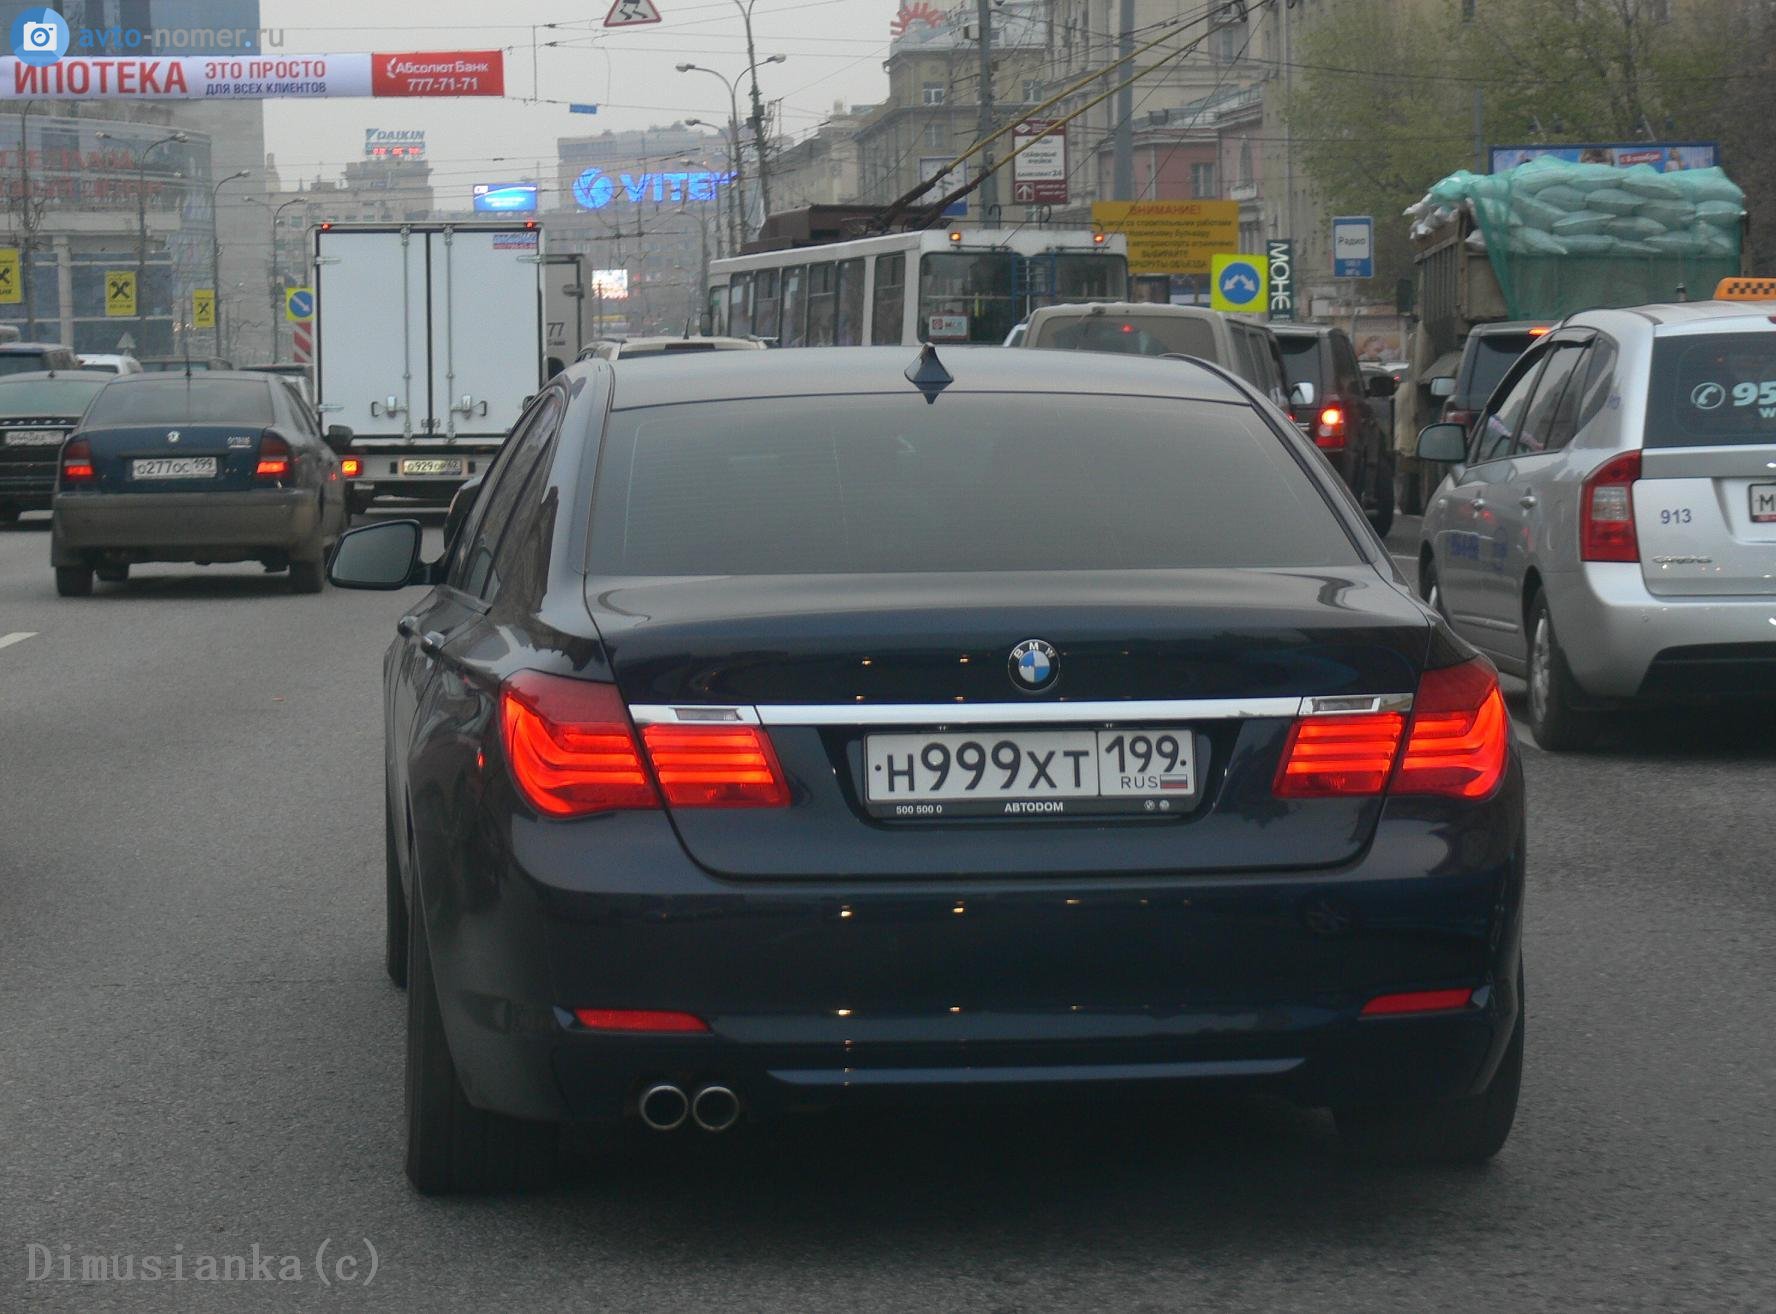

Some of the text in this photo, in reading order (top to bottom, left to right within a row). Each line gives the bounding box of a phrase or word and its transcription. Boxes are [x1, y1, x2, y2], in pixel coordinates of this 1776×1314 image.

[14, 60, 188, 95] ИПОТЕКА
[205, 60, 326, 80] ЭТО ПРОСТО
[205, 81, 326, 96] ДЛЯ ВСЕХ КЛИЕНТОВ
[407, 77, 479, 92] 777-71-71
[377, 130, 425, 140] DAIKIN
[1269, 242, 1291, 310] МОНЕ
[1660, 508, 1692, 525] 913
[1013, 641, 1056, 660] BMW
[887, 735, 1179, 793] Н999ХТ 199
[1120, 775, 1159, 790] RUS
[895, 805, 915, 816] 500
[916, 805, 934, 815] 500
